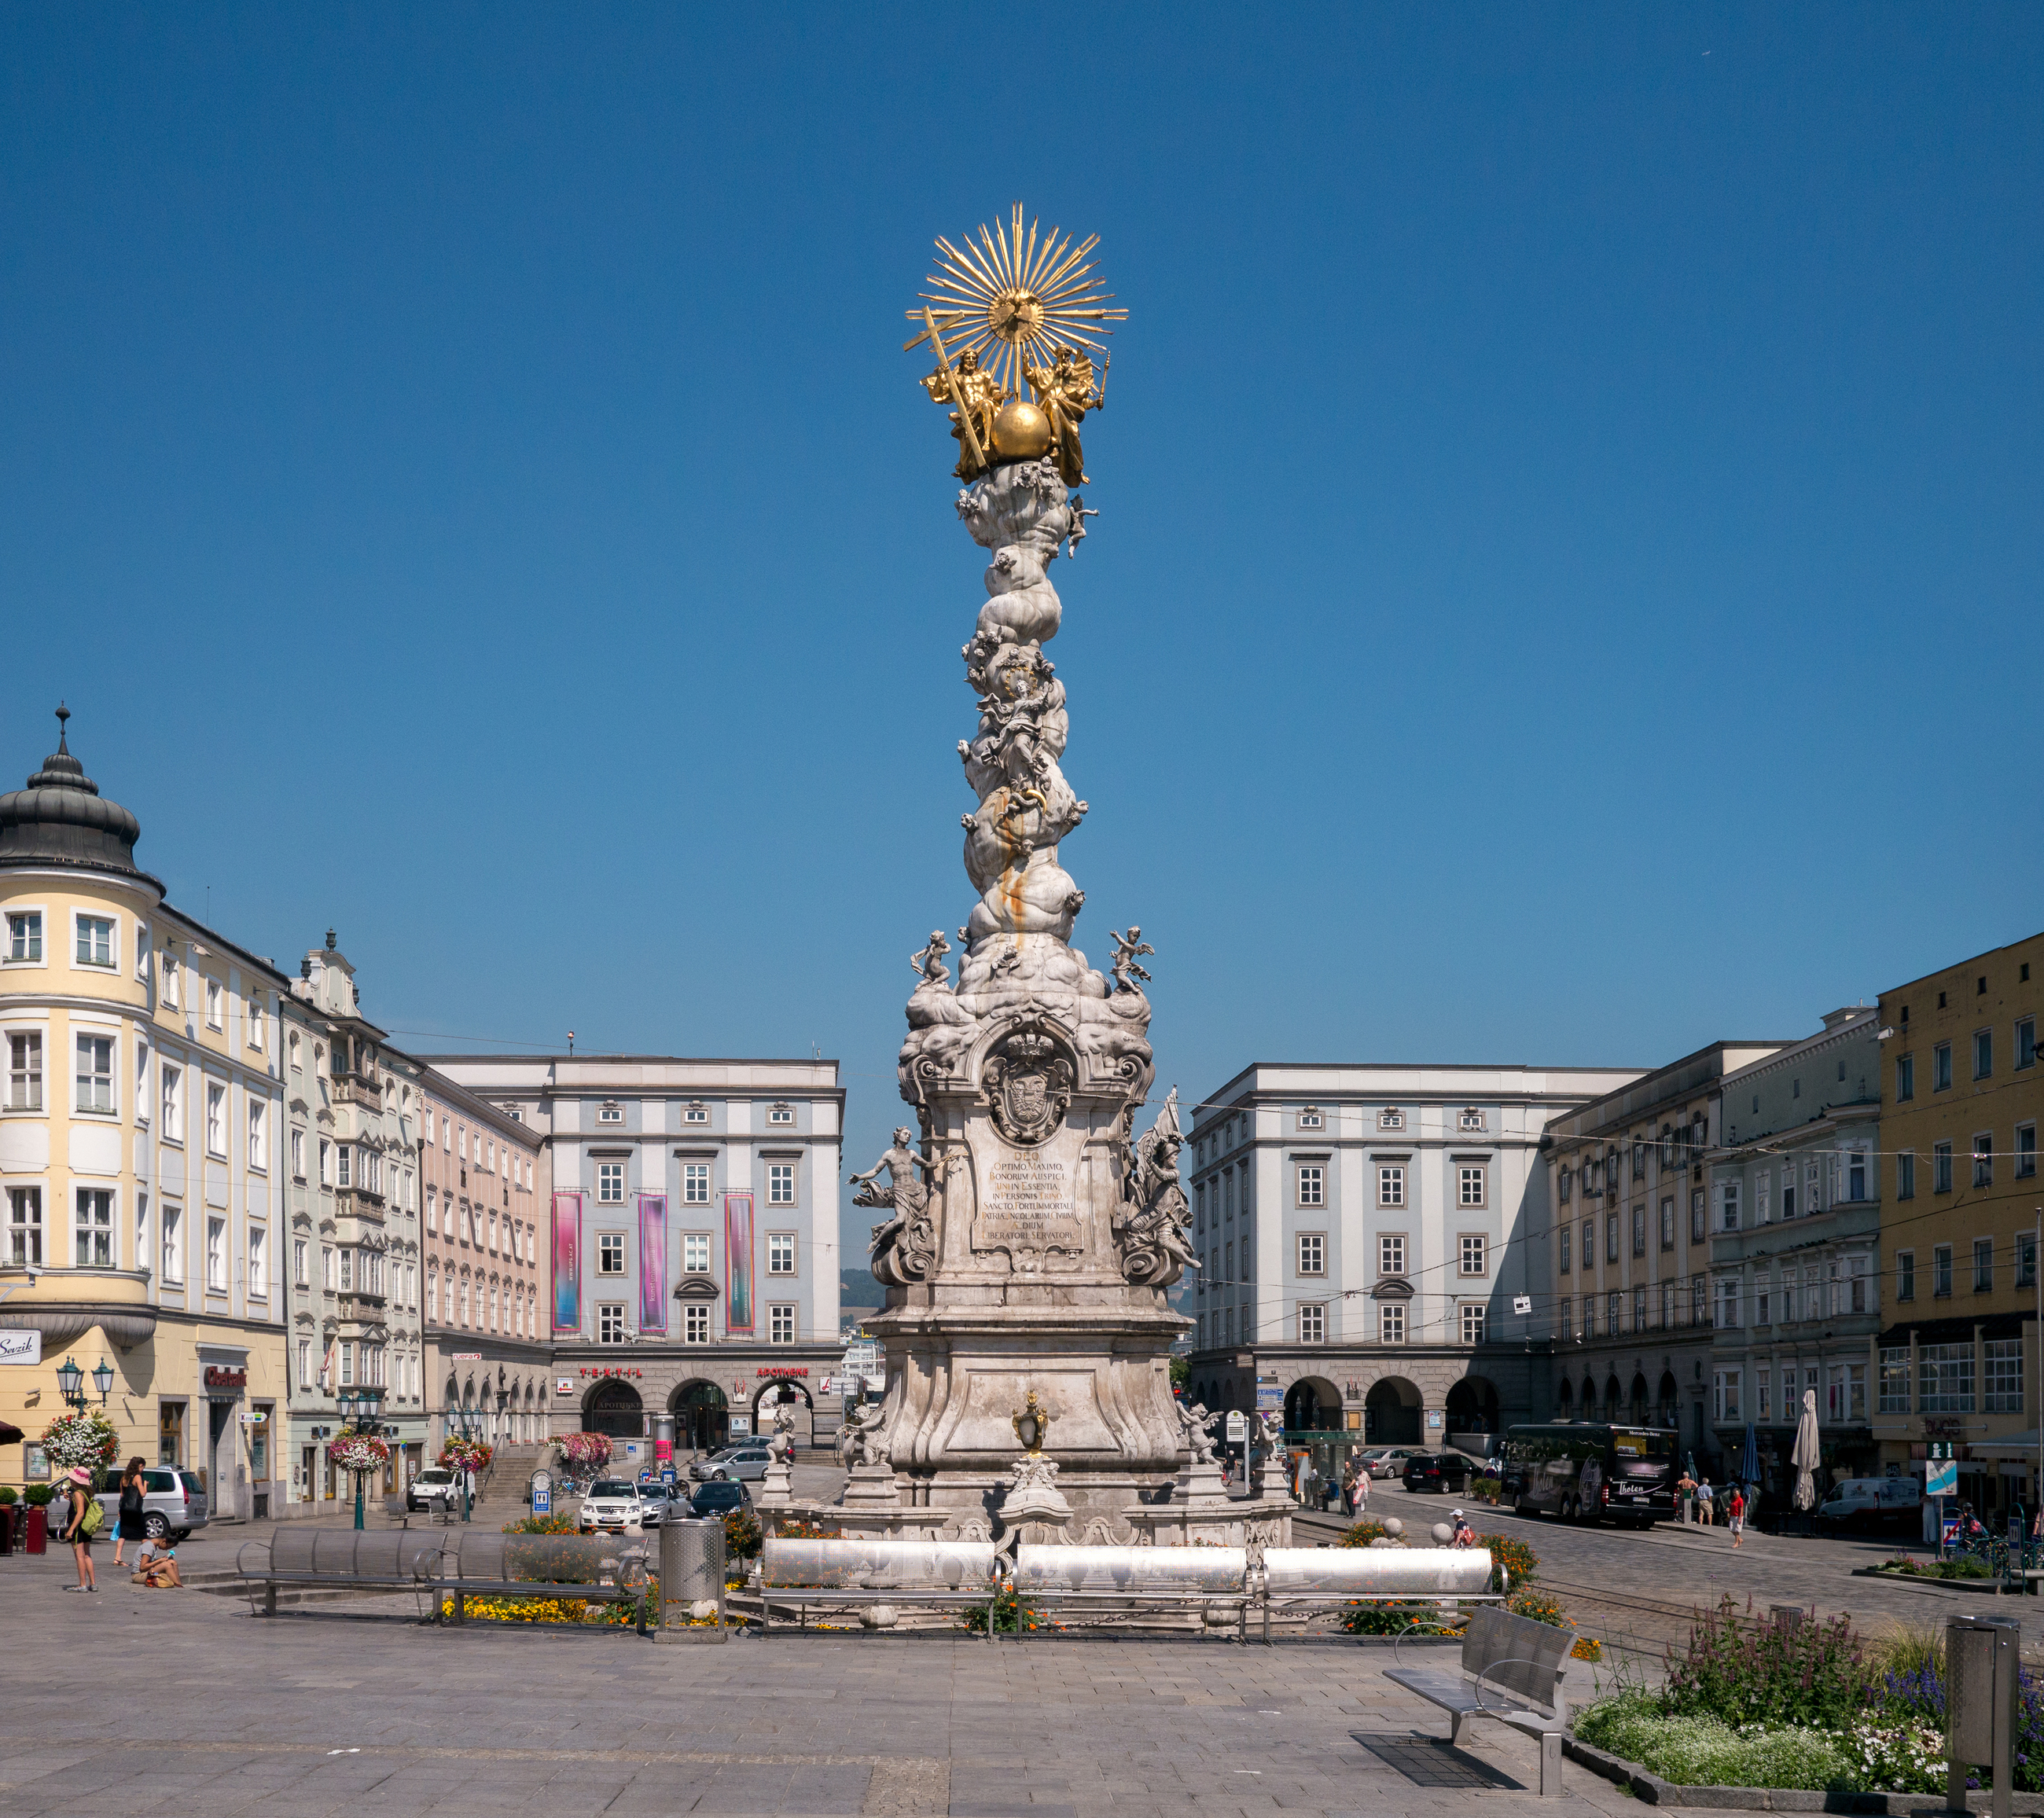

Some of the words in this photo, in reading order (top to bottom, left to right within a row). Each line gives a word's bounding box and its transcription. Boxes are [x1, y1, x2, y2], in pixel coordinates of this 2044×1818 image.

[1014, 1151, 1039, 1161] DEO
[990, 1172, 1028, 1181] BONORUM
[1001, 1192, 1038, 1200] PERSONIS
[208, 1366, 248, 1386] Oberbank
[756, 1367, 808, 1376] APOTHEKE
[1612, 1480, 1643, 1495] Tholen
